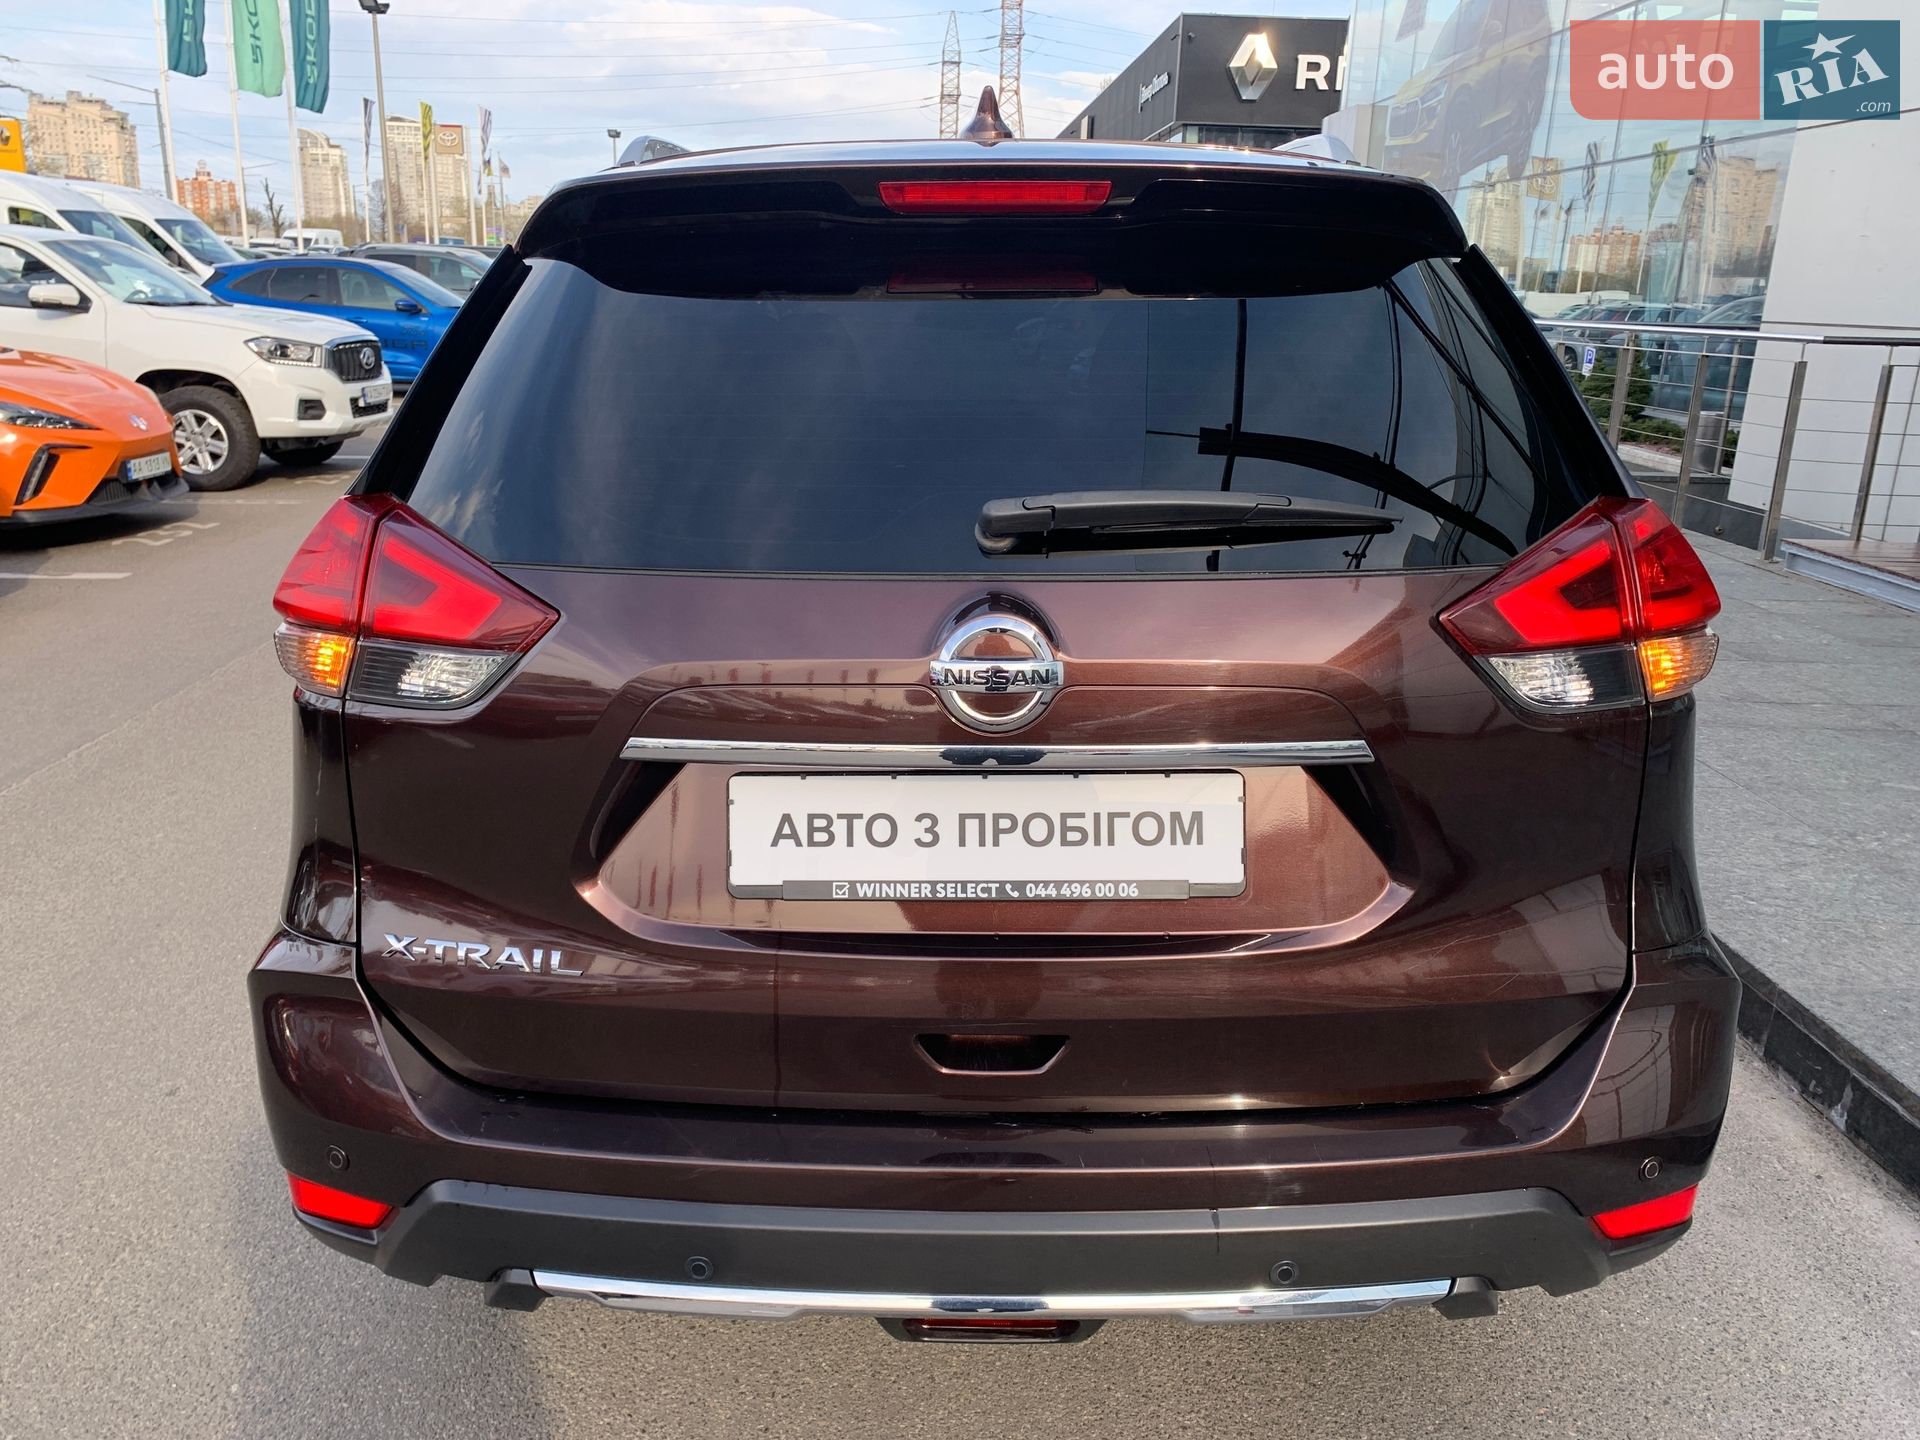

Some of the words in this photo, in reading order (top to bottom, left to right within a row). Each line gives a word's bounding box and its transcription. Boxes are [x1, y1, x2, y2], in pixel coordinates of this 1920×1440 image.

[944, 668, 1050, 685] NISSAN
[770, 812, 899, 848] АВТО
[958, 811, 1204, 847] ПРОБІГОМ
[856, 883, 932, 897] WINNER
[936, 883, 999, 897] SELECT
[1026, 883, 1057, 897] 044
[1061, 883, 1091, 897] 496
[1095, 883, 1116, 897] 00
[1118, 883, 1138, 897] 06
[382, 934, 584, 976] X-TRAIL
